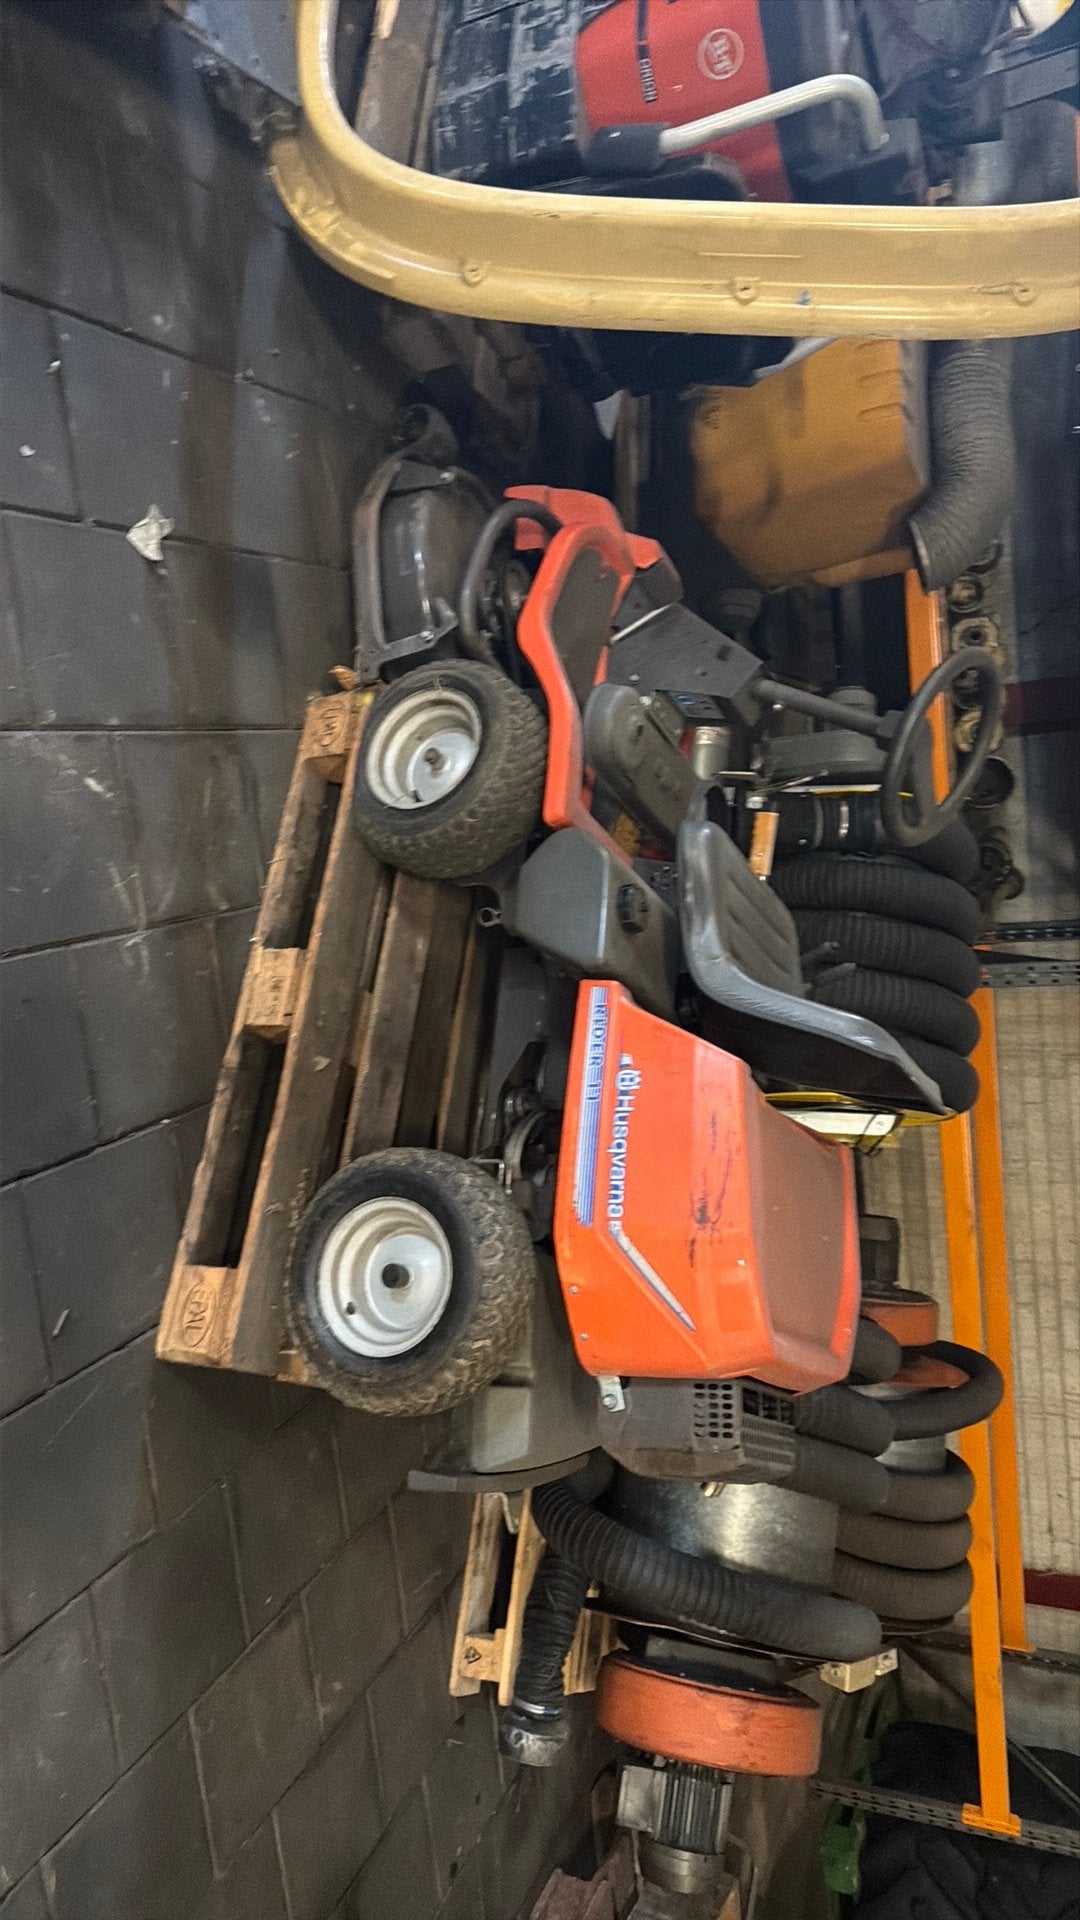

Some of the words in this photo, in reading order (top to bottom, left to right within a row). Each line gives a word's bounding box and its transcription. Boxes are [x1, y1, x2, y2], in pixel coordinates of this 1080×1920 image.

[639, 58, 658, 102] ORION
[589, 1003, 607, 1067] RIDER
[585, 1082, 602, 1103] 11
[606, 1095, 636, 1217] Husqvarna
